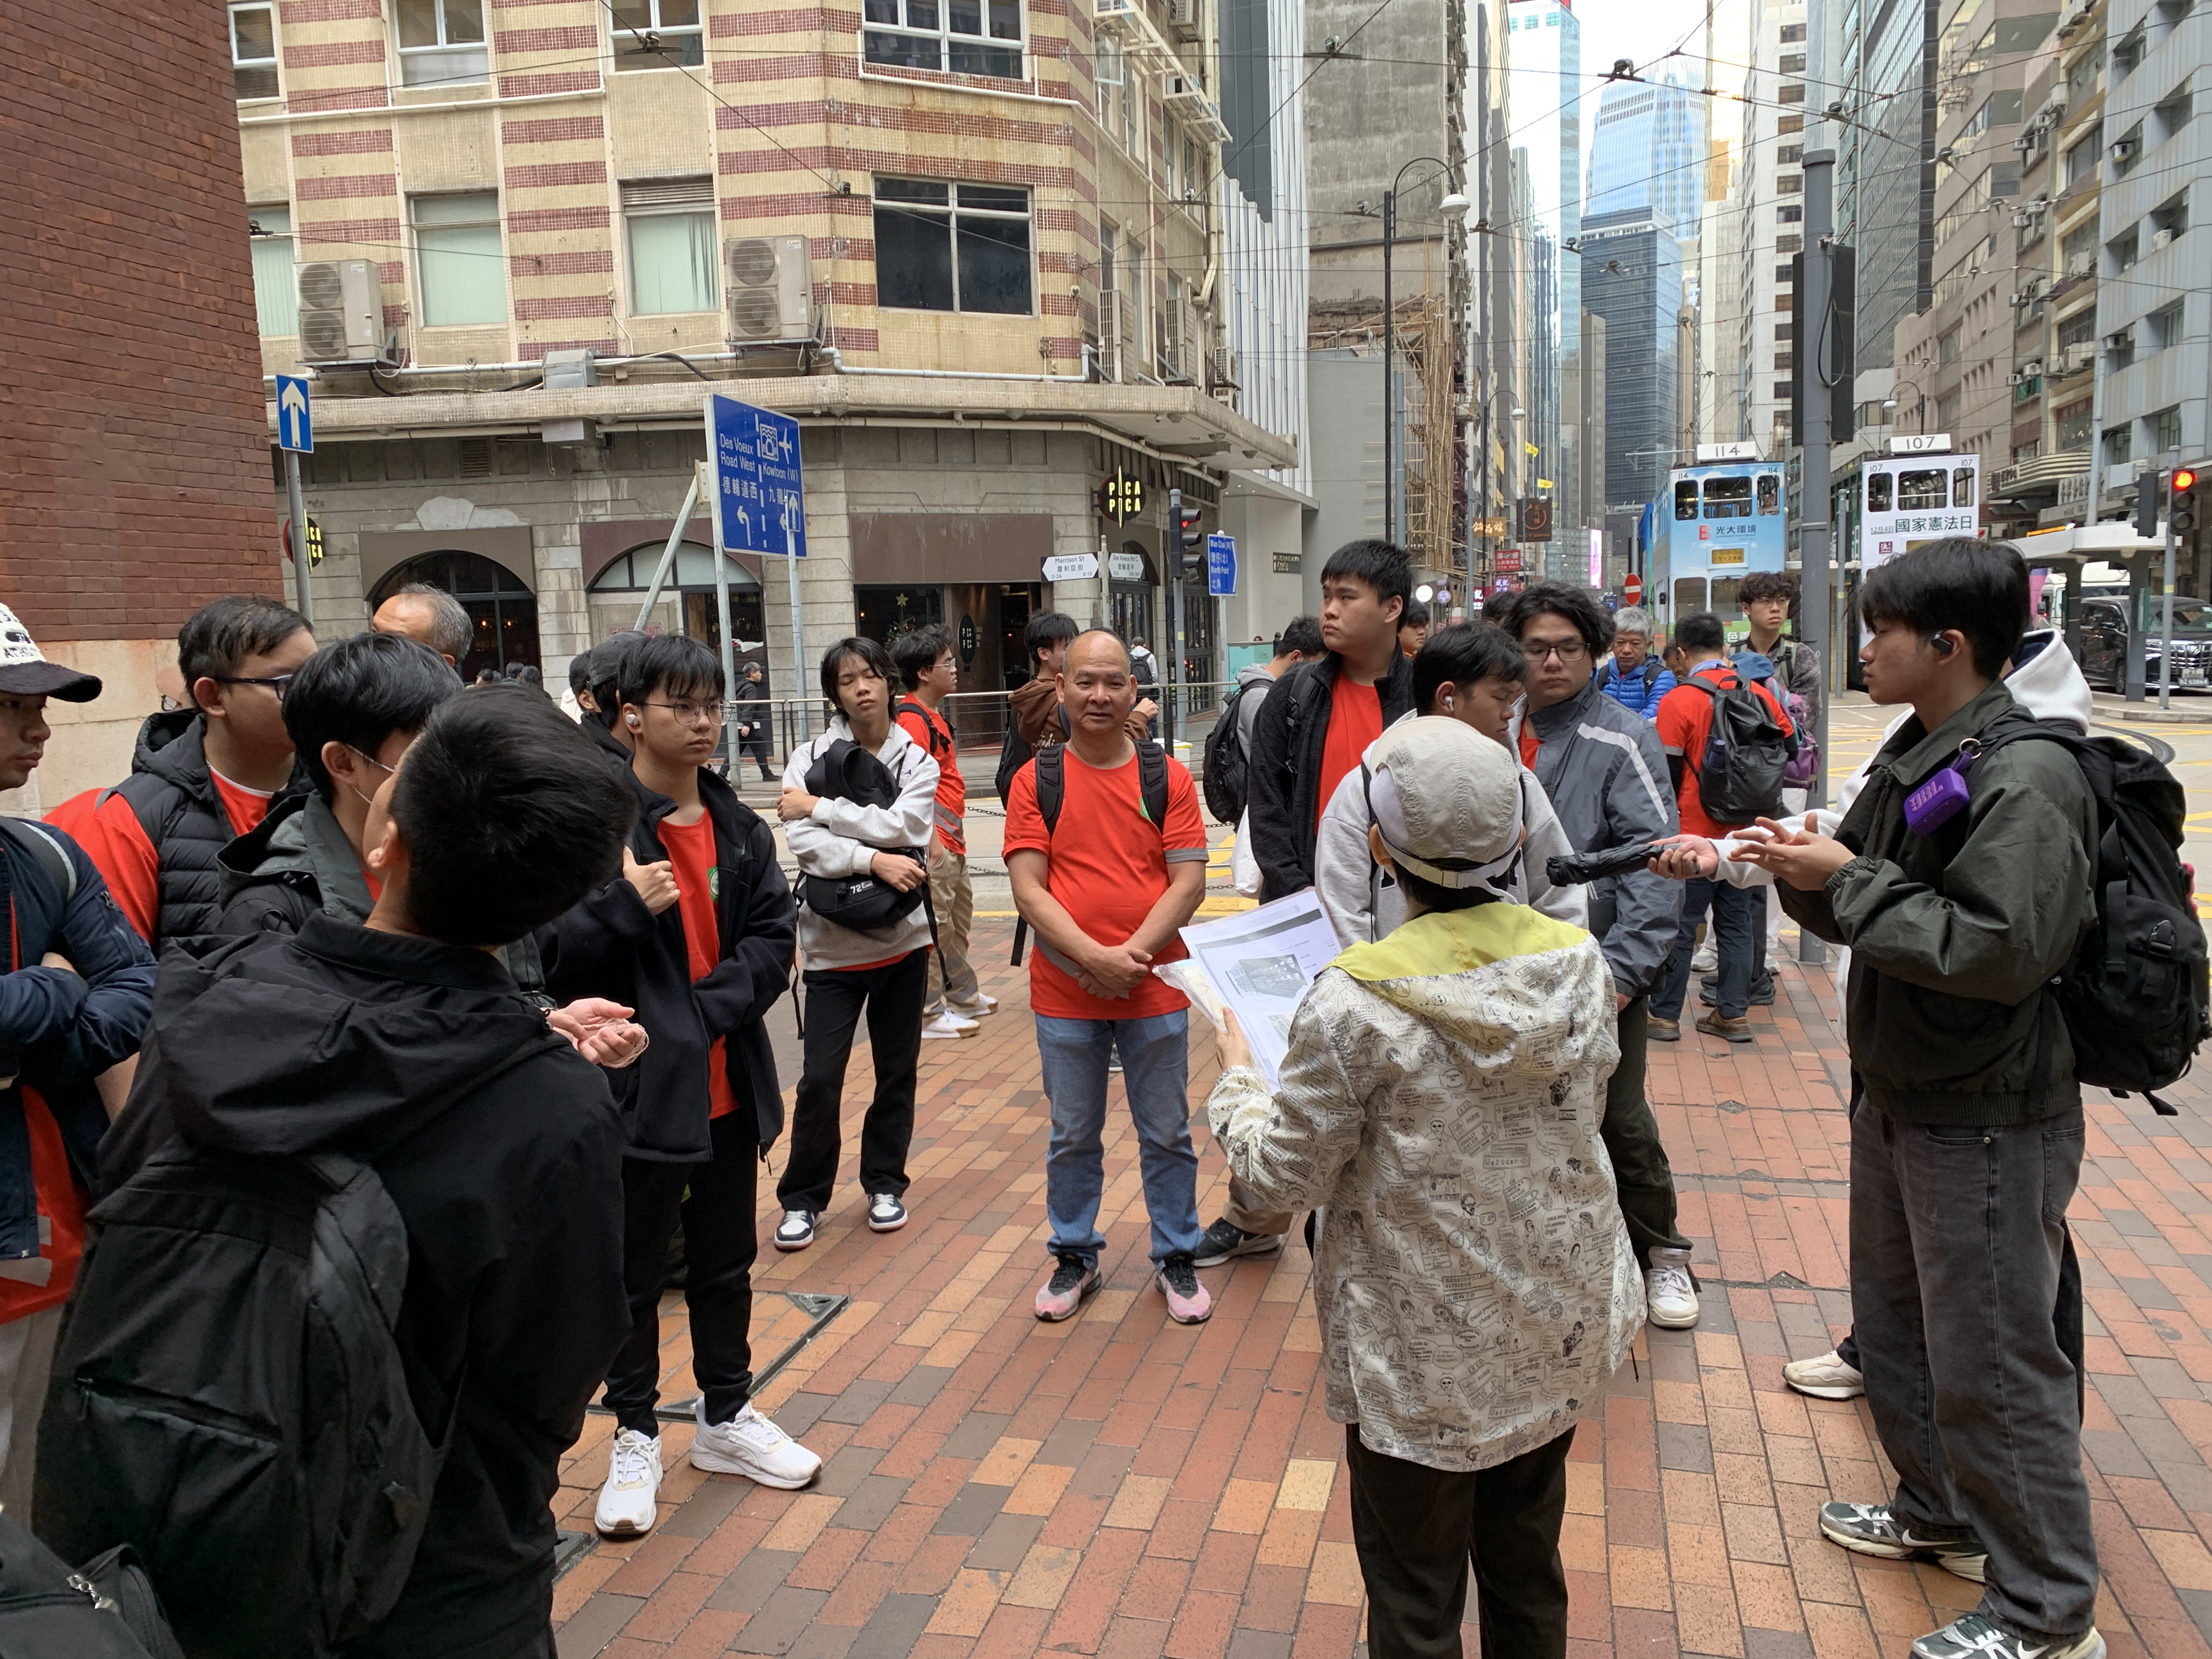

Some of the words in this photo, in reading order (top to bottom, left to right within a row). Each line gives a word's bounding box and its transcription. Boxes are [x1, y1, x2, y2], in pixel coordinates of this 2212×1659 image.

[720, 433, 733, 449] Des
[734, 437, 754, 455] Voeux
[1716, 444, 1741, 457] 114
[1906, 436, 1936, 450] 107
[720, 451, 738, 469] Road
[741, 456, 756, 473] West
[1870, 464, 1883, 472] 107
[762, 462, 786, 480] Kowloon
[787, 467, 799, 483] (W)
[769, 485, 787, 505] 九龍
[1716, 524, 1756, 535] 光大環境
[1895, 516, 1972, 533] 國家憲法日
[1211, 566, 1221, 574] North
[1910, 781, 1943, 812] JBL
[850, 884, 862, 895] 72
